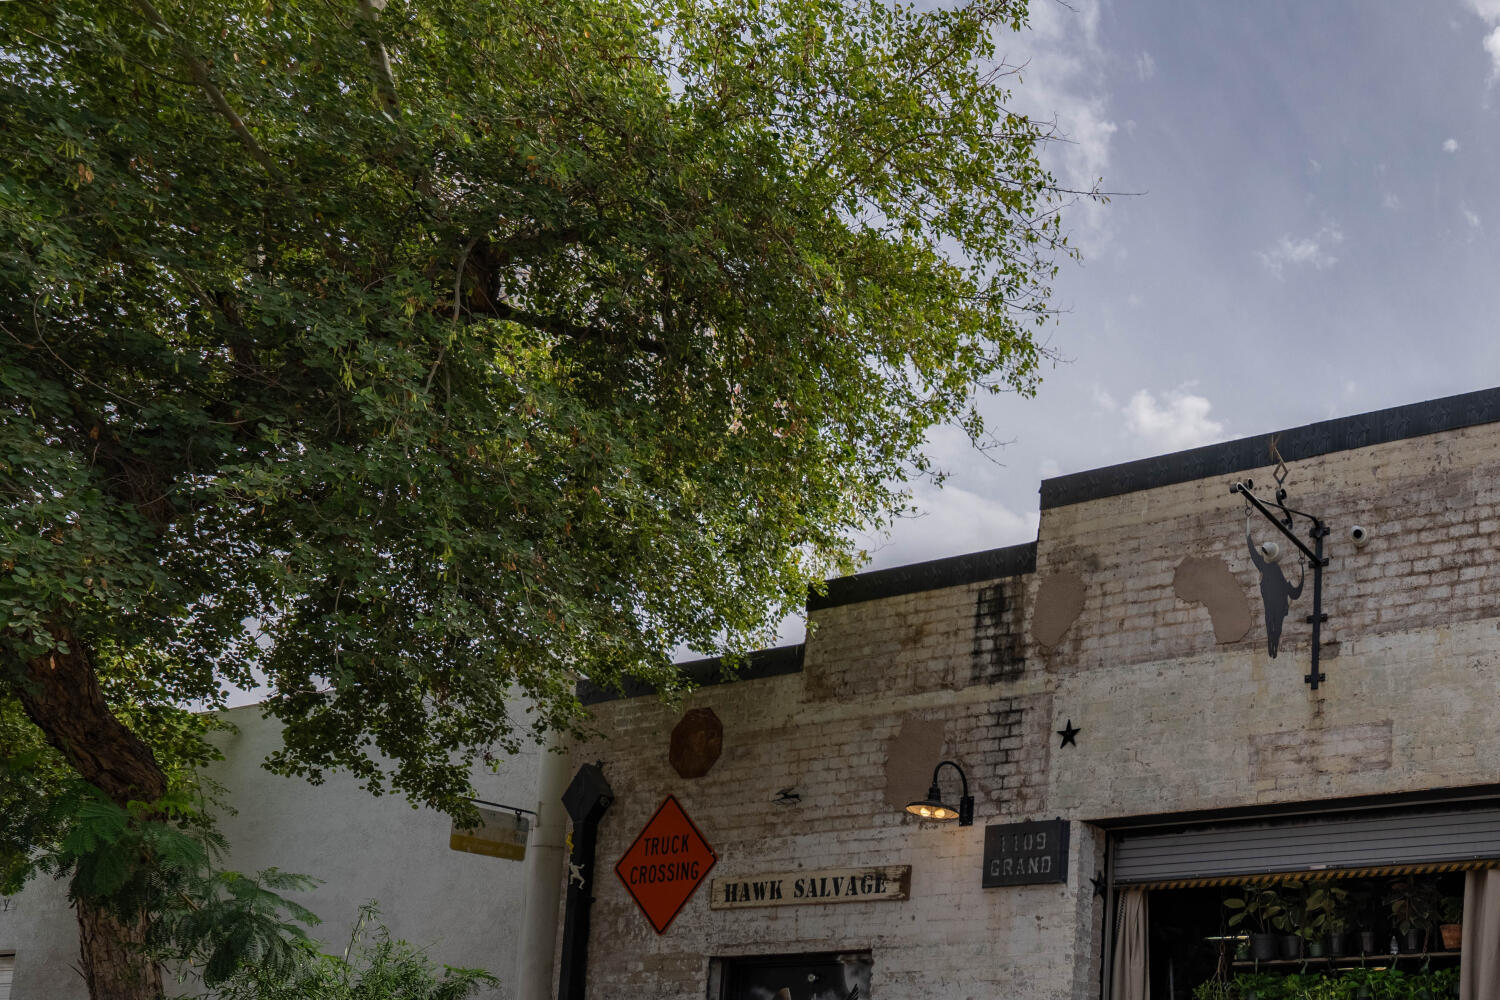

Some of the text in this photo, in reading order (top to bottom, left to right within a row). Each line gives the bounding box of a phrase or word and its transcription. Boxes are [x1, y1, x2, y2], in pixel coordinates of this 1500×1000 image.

[643, 834, 690, 857] TRUCK
[1000, 832, 1047, 853] 1109
[630, 861, 699, 885] CROSSING
[990, 855, 1052, 877] GRAND
[724, 874, 887, 903] HAWK SALVAGE
